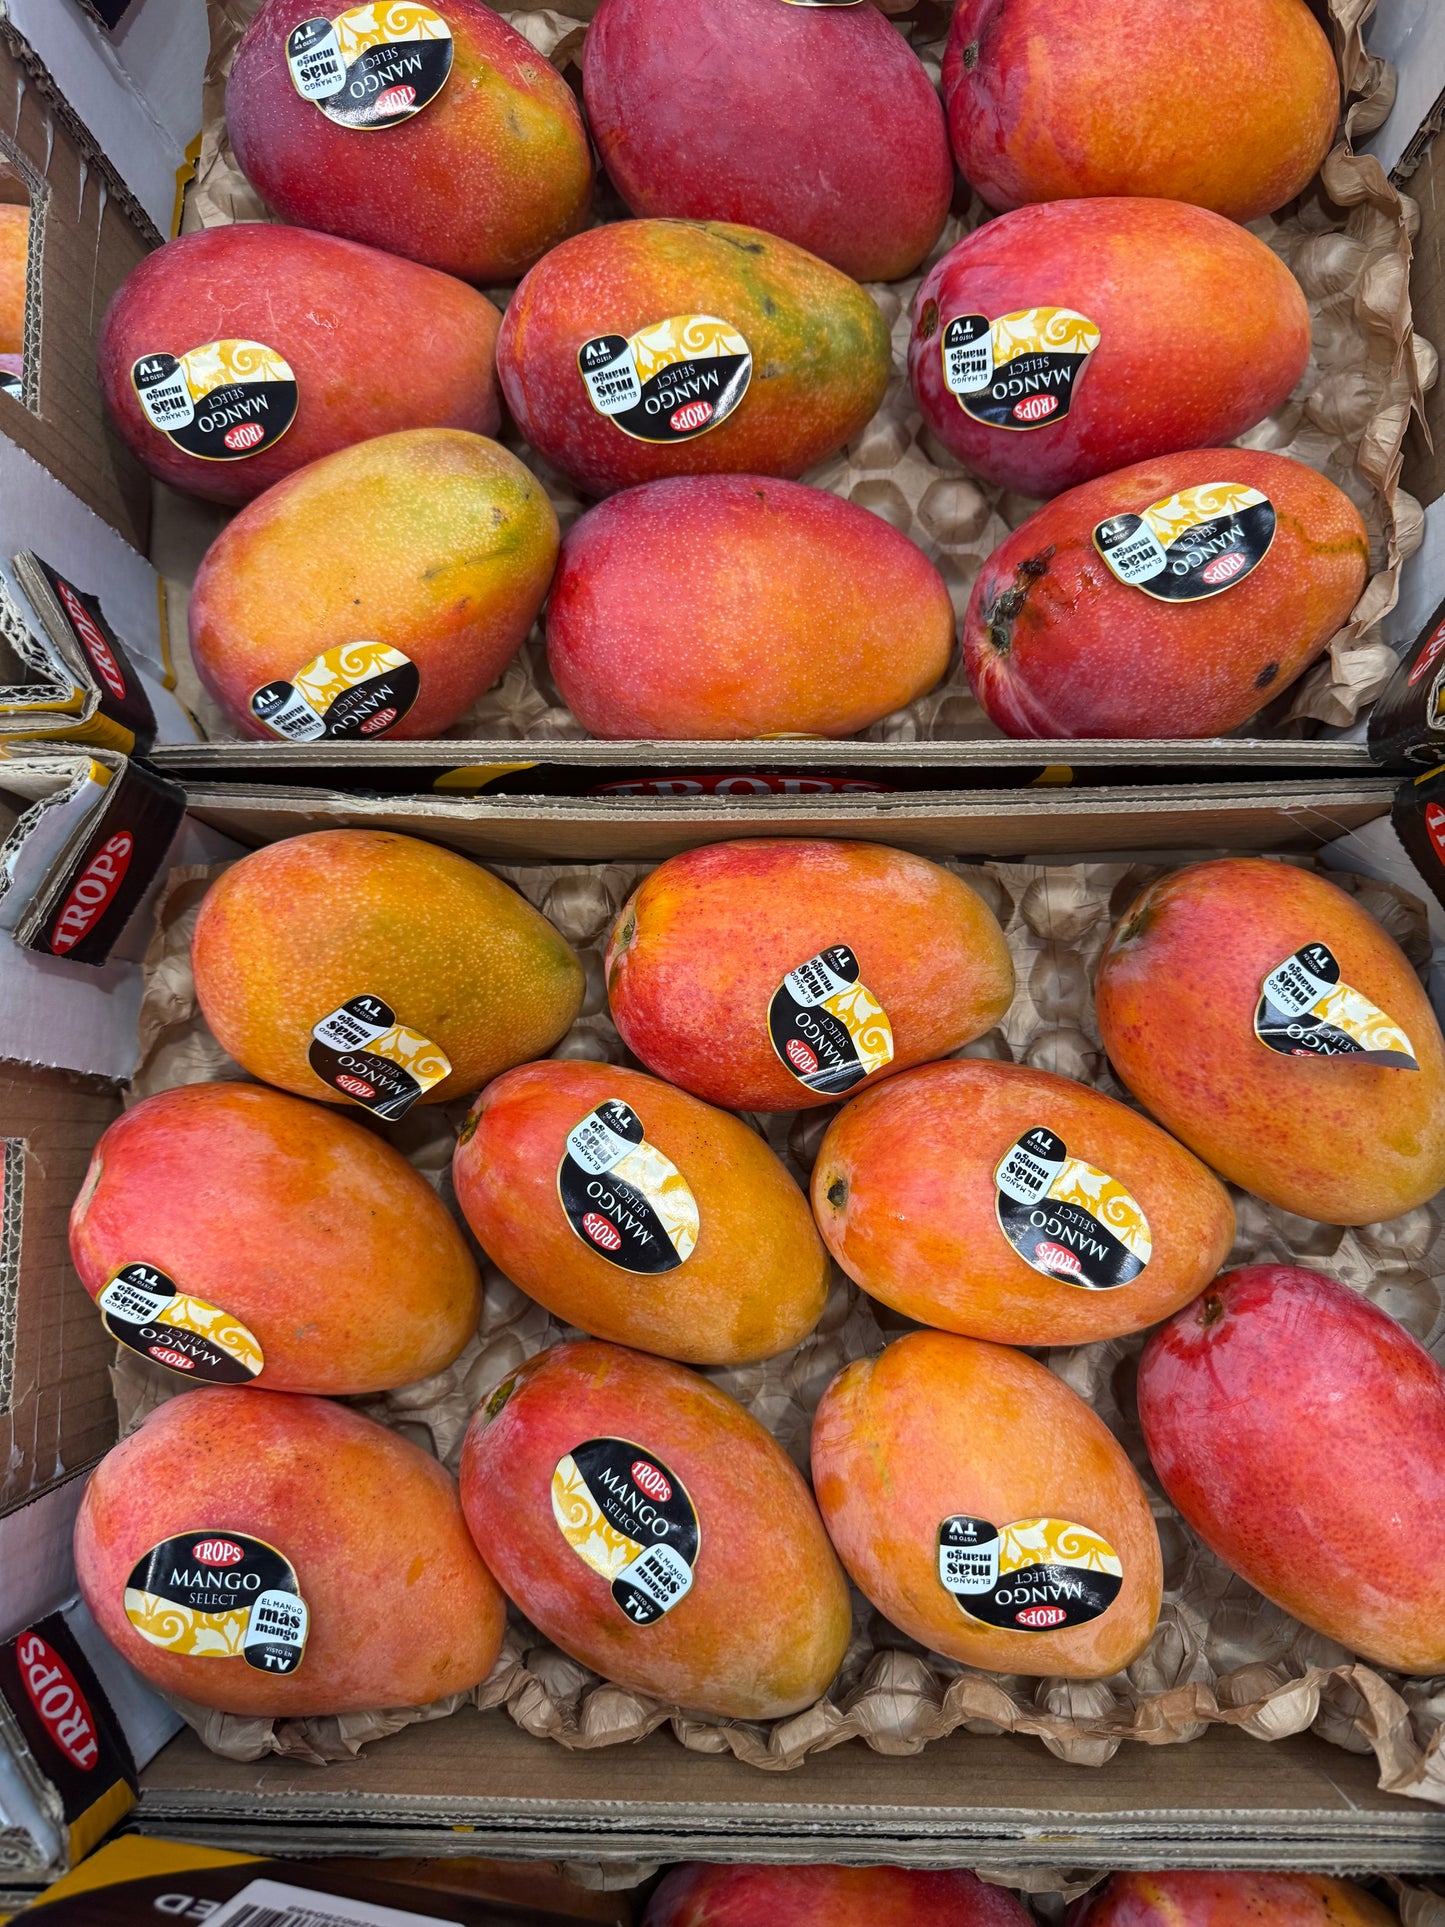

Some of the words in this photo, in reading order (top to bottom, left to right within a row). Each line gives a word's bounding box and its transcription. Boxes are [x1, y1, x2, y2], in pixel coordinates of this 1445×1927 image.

[294, 26, 315, 44] TV
[297, 48, 334, 68] mango
[361, 47, 398, 72] SELECT
[300, 59, 338, 82] más
[350, 54, 423, 98] MANGO
[305, 78, 332, 91] MANGO
[376, 87, 413, 114] TROPS
[952, 320, 973, 335] TV
[586, 341, 610, 357] TV
[951, 348, 986, 362] mango
[140, 361, 162, 375] TV
[592, 367, 630, 384] mango
[657, 364, 695, 389] SELECT
[952, 359, 986, 378] más
[1008, 356, 1049, 376] SELECT
[596, 378, 633, 398] más
[952, 375, 978, 384] MANGO
[993, 366, 1070, 399] MANGO
[146, 385, 182, 401] mango
[208, 388, 244, 409] SELECT
[600, 395, 628, 406] MANGO
[629, 391, 637, 399] EL
[645, 370, 719, 414] MANGO
[151, 396, 186, 414] más
[199, 394, 269, 432] MANGO
[671, 403, 712, 429] TROPS
[1015, 396, 1056, 418] TROPS
[156, 412, 181, 422] MANGO
[225, 425, 264, 447] TROPS
[1101, 522, 1125, 538] TV
[1180, 524, 1217, 551] SELECT
[1112, 537, 1150, 560] mango
[1118, 546, 1158, 570] más
[1172, 526, 1246, 575] MANGO
[1125, 563, 1152, 578] MANGO
[1153, 558, 1162, 566] EL
[1204, 554, 1245, 583] TROPS
[61, 587, 123, 694] TROPS
[255, 690, 279, 708] TV
[337, 688, 367, 716] SELECT
[273, 705, 305, 725] mango
[282, 713, 316, 733] más
[362, 708, 396, 733] TROPS
[55, 837, 131, 946] TROPS
[834, 948, 850, 967] TV
[1309, 947, 1330, 969] TV
[791, 972, 806, 995] MANGO
[799, 965, 824, 998] más
[811, 960, 833, 991] mango
[1288, 963, 1317, 996] mango
[1269, 980, 1291, 1004] MANGO
[1277, 971, 1309, 1005] más
[359, 999, 381, 1017] TV
[1290, 1004, 1299, 1012] EL
[319, 1028, 341, 1044] MANGO
[327, 1021, 362, 1045] más
[338, 1015, 371, 1038] mango
[820, 1018, 848, 1047] SELECT
[796, 1013, 845, 1072] MANGO
[1287, 1024, 1343, 1055] NGO
[367, 1057, 402, 1077] SELECT
[788, 1040, 817, 1073] TROPS
[338, 1056, 407, 1095] MANGO
[338, 1075, 374, 1096] TROPS
[611, 1106, 631, 1128] TV
[572, 1137, 593, 1161] MANGO
[1031, 1131, 1053, 1150] TV
[592, 1162, 600, 1170] EL
[1007, 1161, 1043, 1191] más
[1015, 1152, 1049, 1179] mango
[1001, 1173, 1028, 1193] MANGO
[613, 1184, 649, 1217] SELECT
[1027, 1191, 1036, 1199] EL
[587, 1182, 653, 1245] MANGO
[1055, 1206, 1097, 1233] SELECT
[585, 1214, 620, 1249] TROPS
[1030, 1211, 1109, 1261] MANGO
[1038, 1243, 1080, 1273] TROPS
[132, 1268, 159, 1286] TV
[105, 1300, 136, 1316] MANGO
[111, 1292, 152, 1316] más
[118, 1285, 158, 1309] mango
[140, 1328, 222, 1365] MANGO
[165, 1328, 209, 1347] SELECT
[151, 1347, 194, 1368] TROPS
[632, 1462, 670, 1500] TROPS
[599, 1468, 669, 1536] MANGO
[603, 1498, 642, 1535] SELECT
[950, 1522, 977, 1536] TV
[195, 1542, 241, 1561] TROPS
[947, 1550, 991, 1561] mango
[644, 1556, 679, 1594] más
[655, 1548, 663, 1559] EL
[665, 1560, 687, 1584] MANGO
[947, 1563, 990, 1577] más
[1015, 1570, 1059, 1584] SELECT
[170, 1568, 261, 1590] MANGO
[636, 1566, 669, 1602] mango
[189, 1593, 237, 1605] SELECT
[996, 1582, 1082, 1605] MANGO
[259, 1607, 301, 1628] más
[273, 1602, 303, 1614] MANGO
[626, 1596, 649, 1620] TV
[1019, 1609, 1065, 1624] TROPS
[256, 1623, 298, 1641] mango
[264, 1654, 291, 1670] TV
[21, 1637, 98, 1765] TROPS
